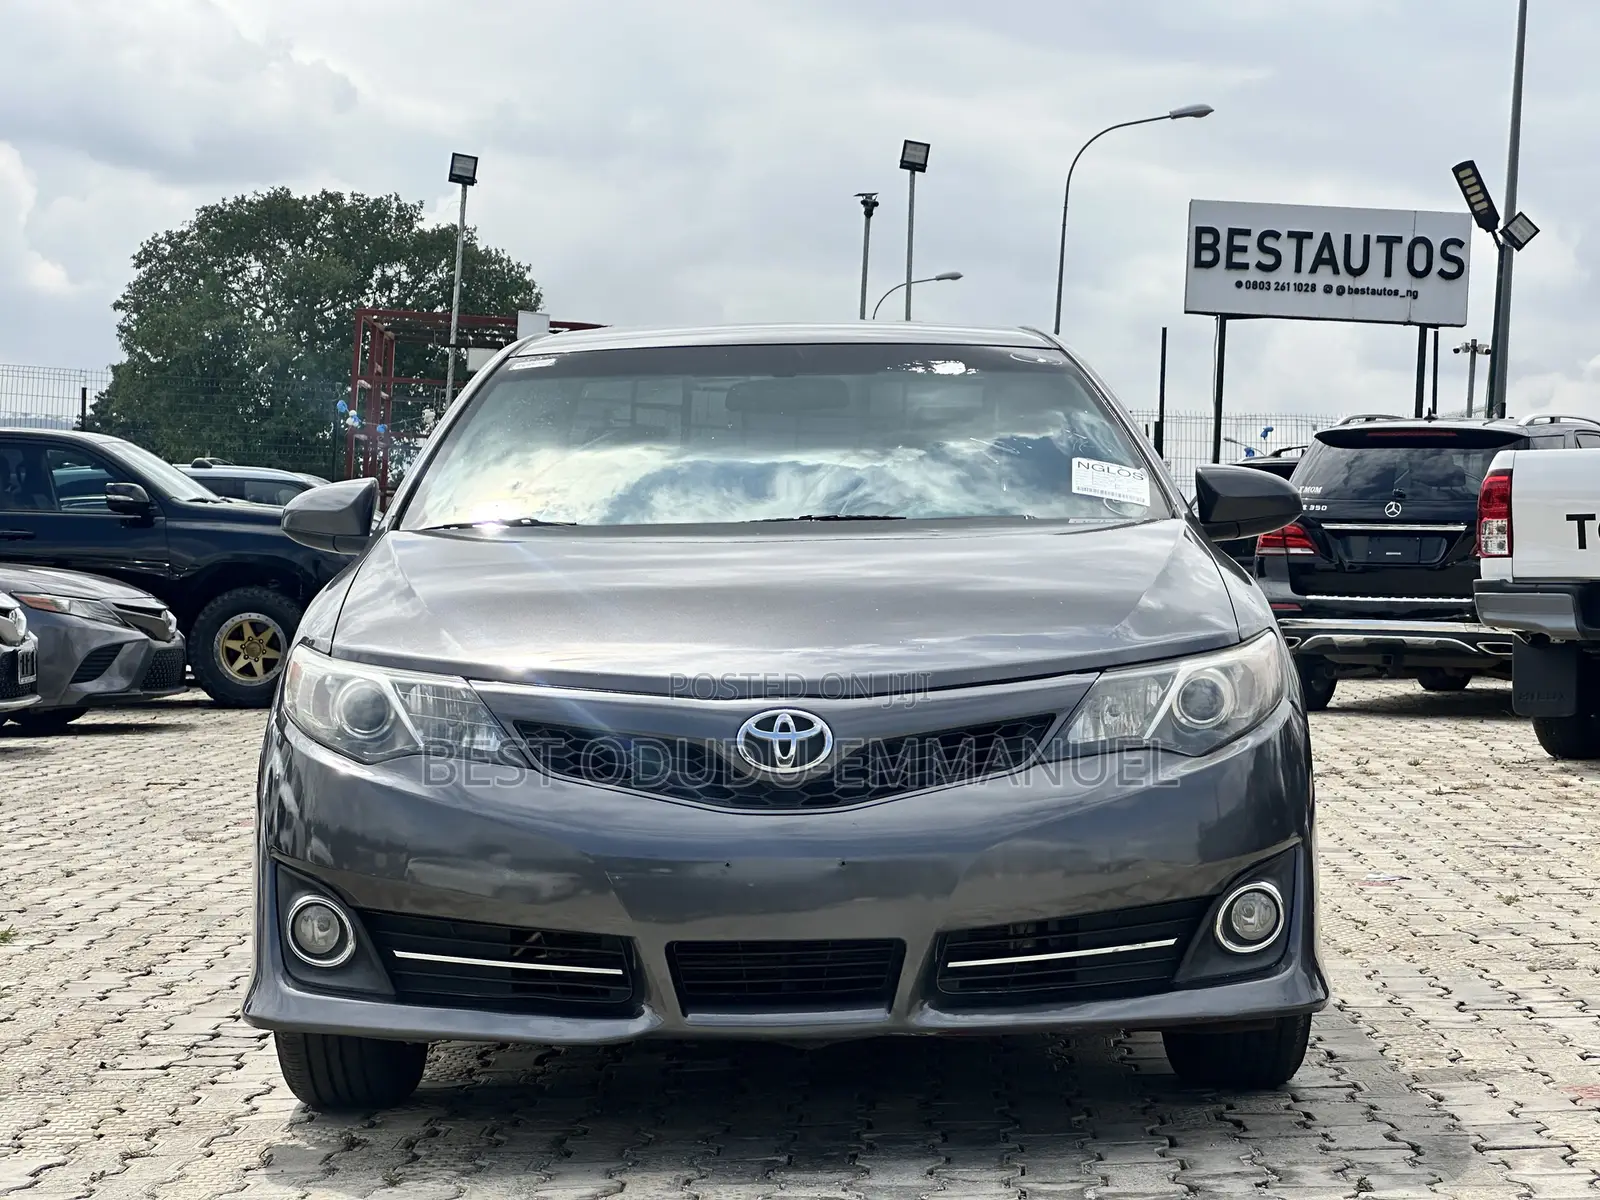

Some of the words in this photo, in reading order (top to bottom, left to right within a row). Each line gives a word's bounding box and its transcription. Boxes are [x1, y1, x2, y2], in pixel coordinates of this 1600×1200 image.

[1194, 226, 1466, 280] BESTAUTOS
[1245, 280, 1271, 291] 0803
[1274, 282, 1290, 292] 261
[1293, 283, 1316, 292] 1028
[1077, 461, 1144, 480] NGLOS
[1566, 513, 1600, 550] T
